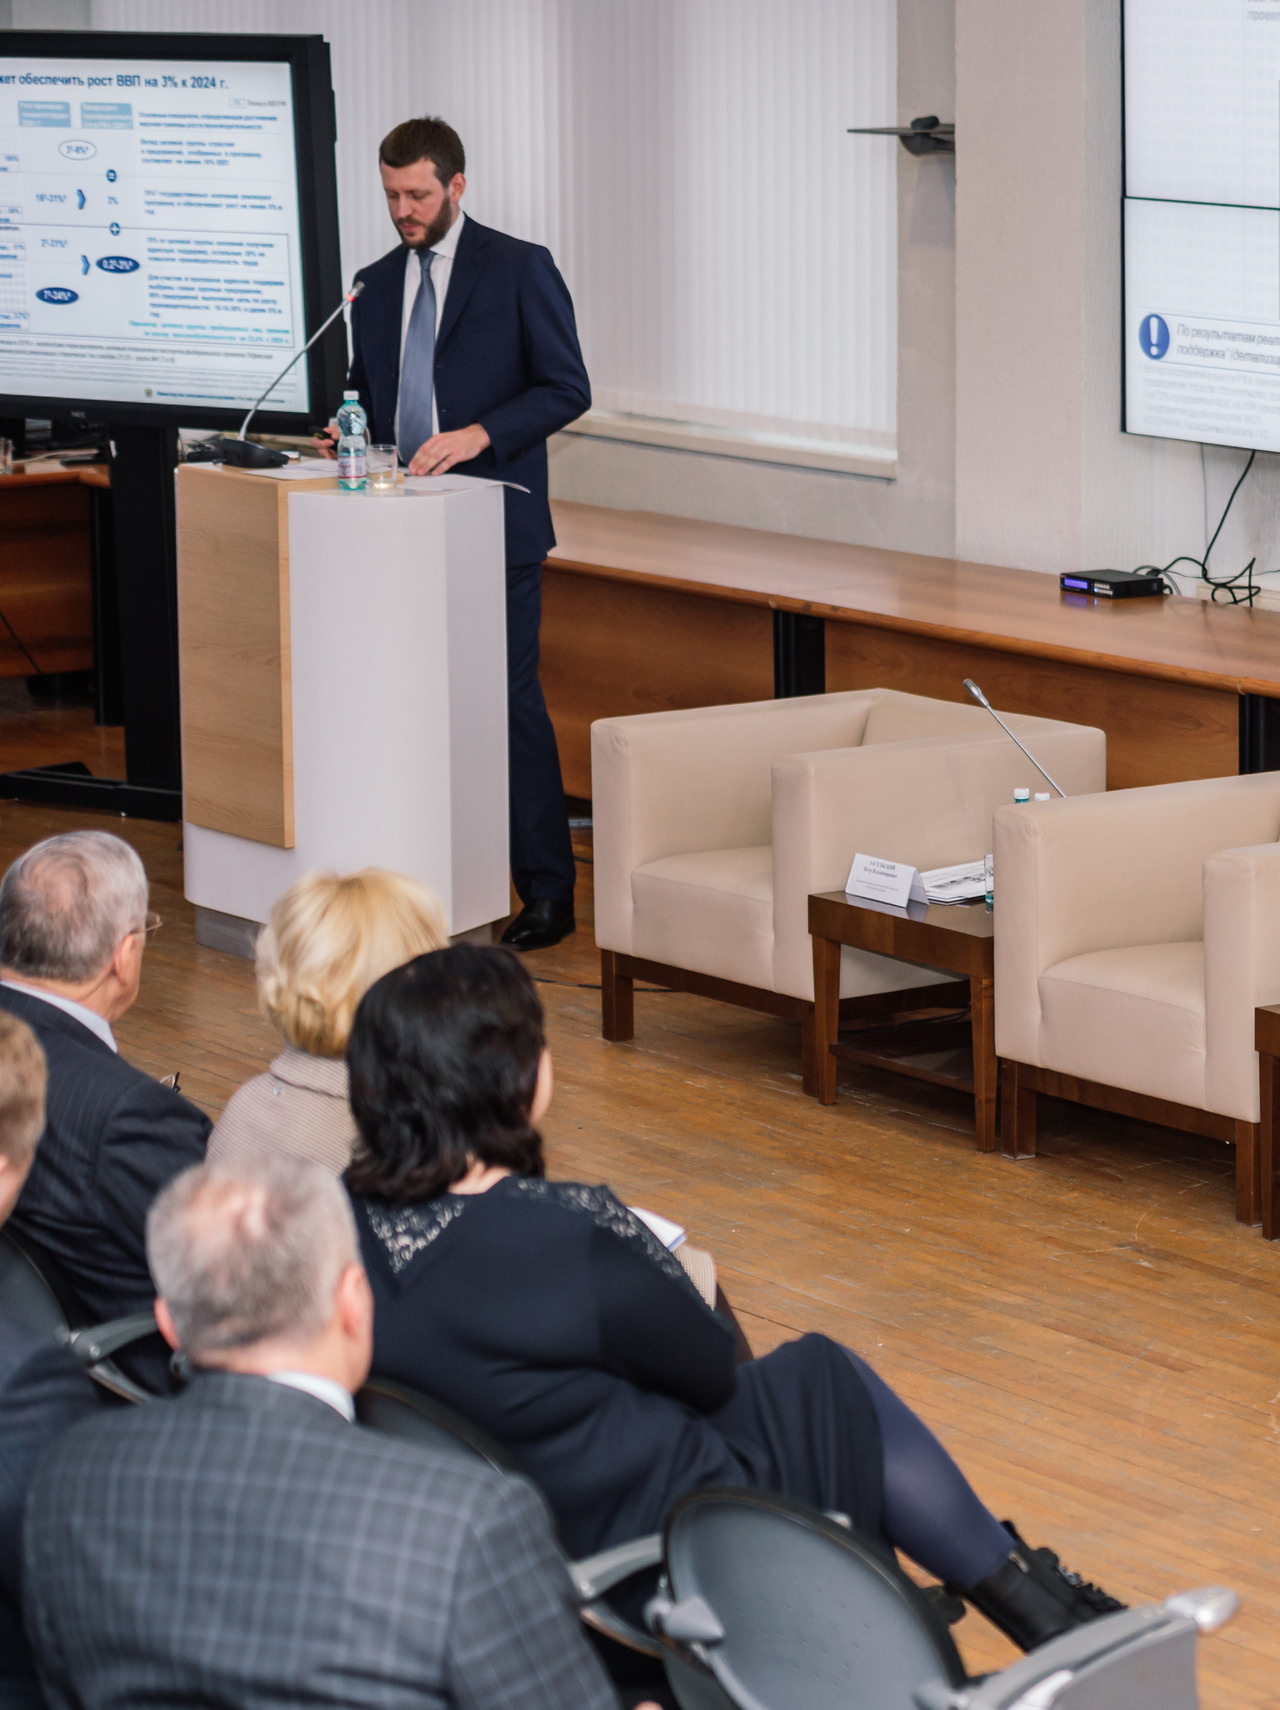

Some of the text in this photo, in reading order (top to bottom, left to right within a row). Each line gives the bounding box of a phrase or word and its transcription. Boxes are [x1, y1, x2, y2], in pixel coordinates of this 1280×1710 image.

[19, 72, 84, 86] обеспечить
[88, 77, 112, 88] рост
[116, 75, 140, 87] ВВП
[145, 77, 158, 87] на
[161, 76, 178, 88] 3%
[182, 79, 187, 88] к
[191, 76, 216, 88] 2024
[1177, 323, 1190, 336] По
[1191, 327, 1255, 345] результатам
